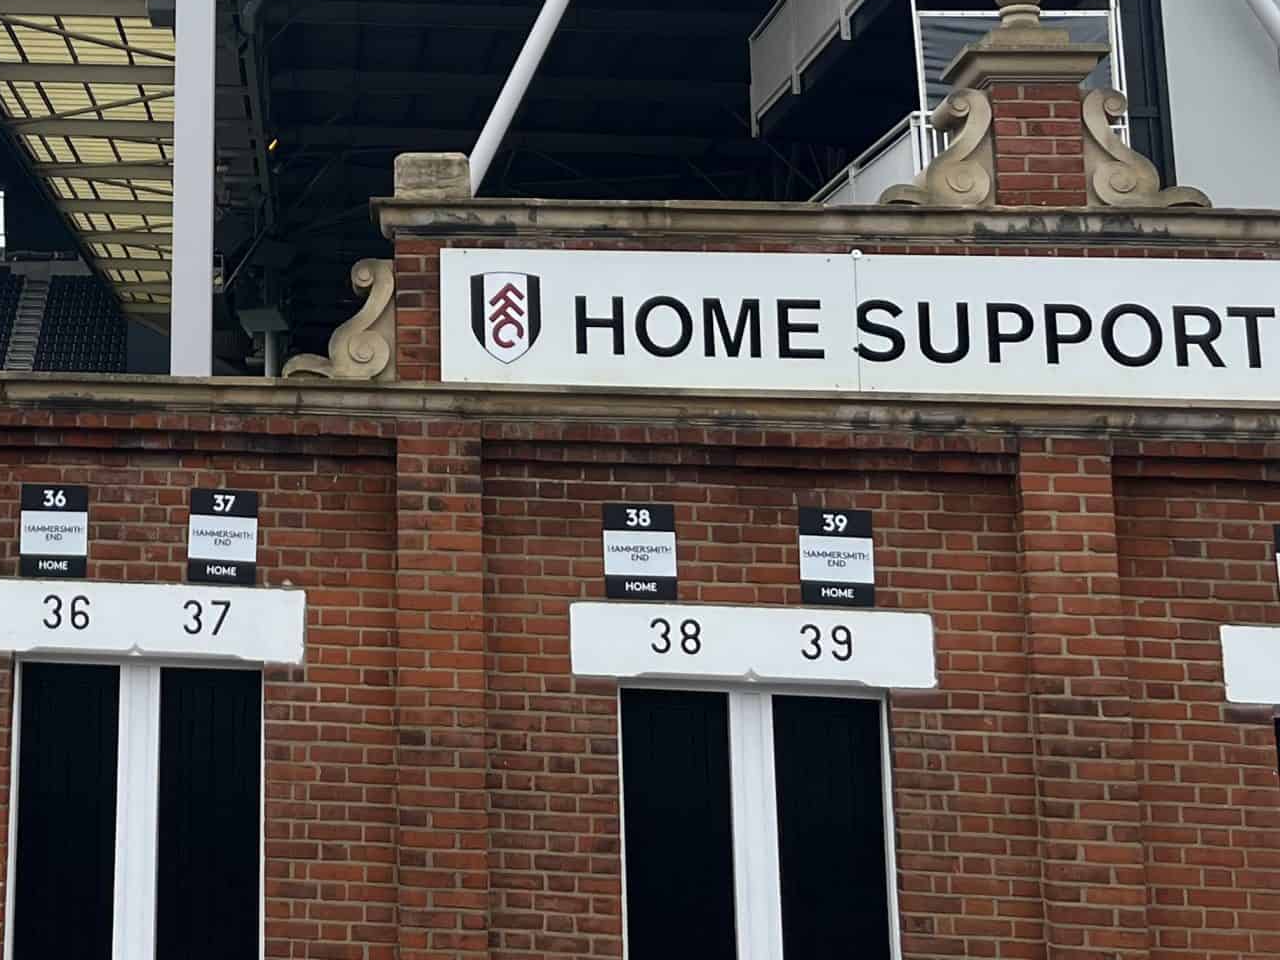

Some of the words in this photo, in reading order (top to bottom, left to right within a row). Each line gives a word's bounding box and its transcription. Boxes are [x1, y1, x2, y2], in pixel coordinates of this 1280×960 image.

[575, 295, 825, 359] HOME
[854, 298, 1275, 369] SUPPORT
[43, 490, 66, 507] 36
[213, 494, 236, 512] 37
[625, 509, 651, 527] 38
[822, 513, 848, 532] 39
[24, 524, 84, 534] HAMMERSMITH
[192, 529, 253, 540] HAMMERSMITH
[45, 533, 63, 542] END
[214, 538, 232, 547] END
[607, 545, 672, 555] HAMMERSMITH
[803, 550, 870, 561] HAMMERSMITH
[631, 554, 649, 562] END
[827, 559, 846, 568] END
[38, 560, 68, 571] HOME
[206, 565, 237, 577] HOME
[624, 581, 657, 592] HOME
[821, 587, 854, 599] HOME
[42, 594, 91, 630] 36
[183, 599, 232, 636] 37
[650, 617, 702, 655] 38
[800, 624, 853, 662] 39
